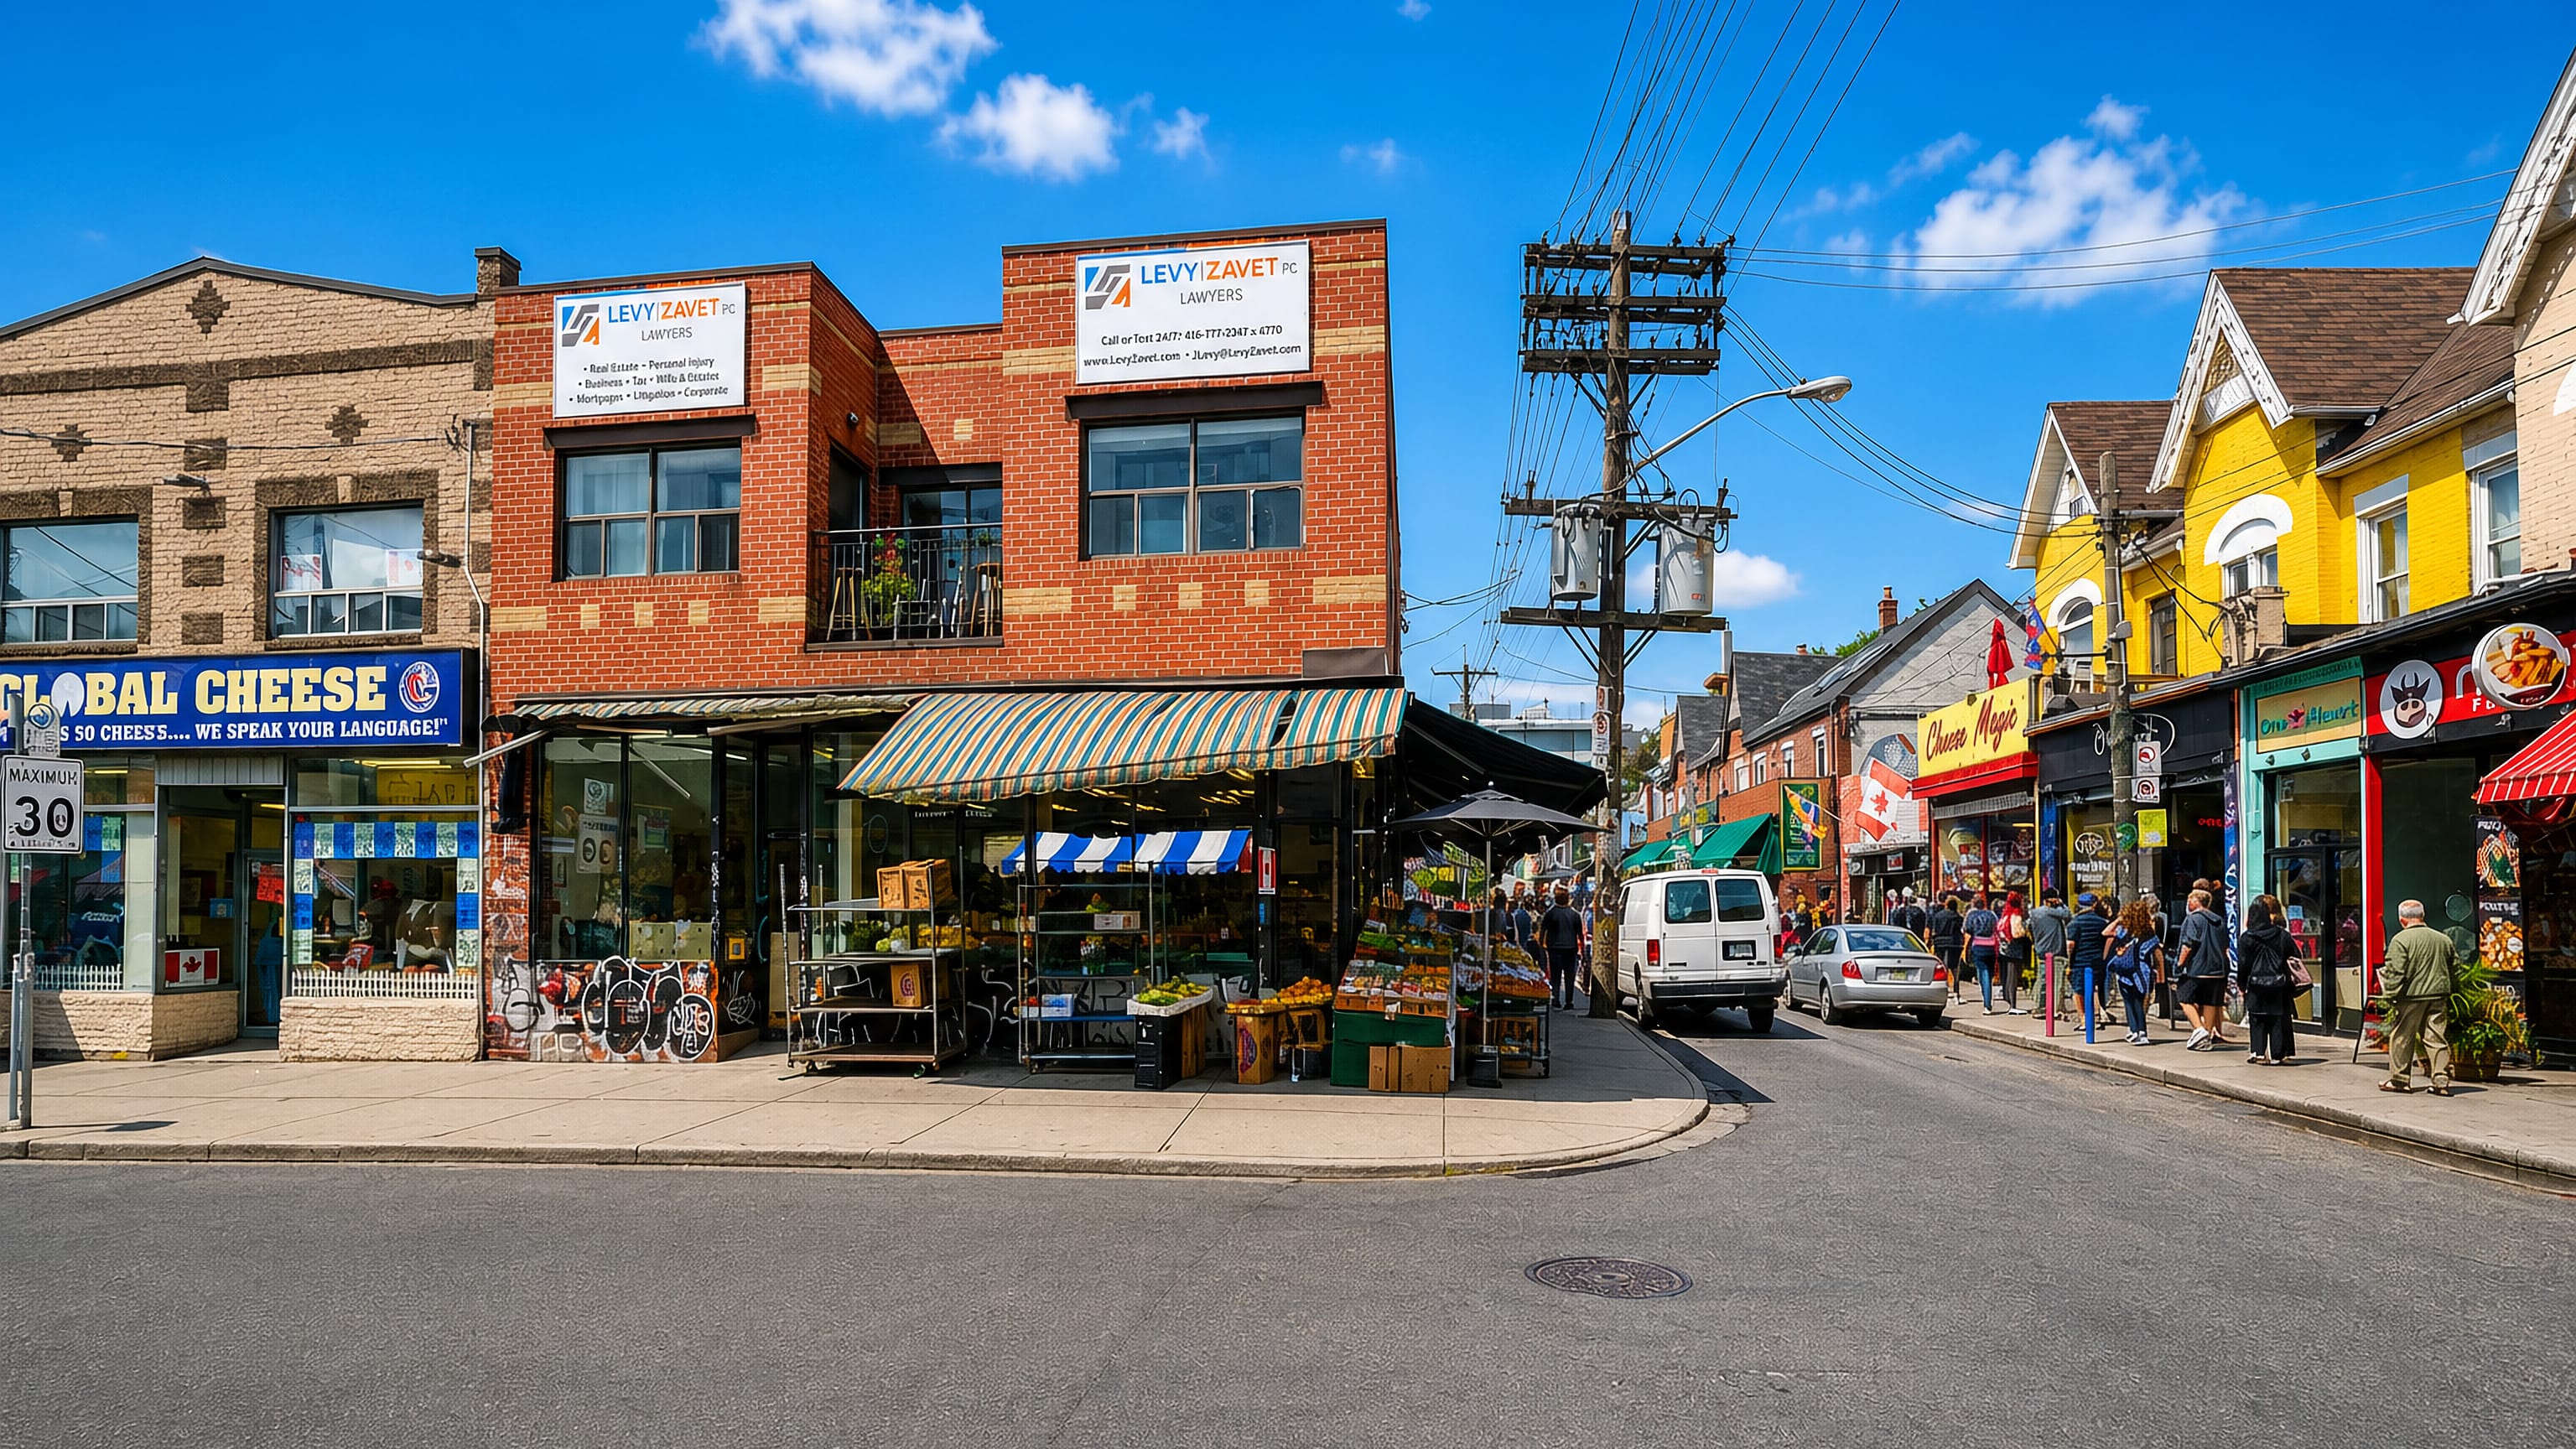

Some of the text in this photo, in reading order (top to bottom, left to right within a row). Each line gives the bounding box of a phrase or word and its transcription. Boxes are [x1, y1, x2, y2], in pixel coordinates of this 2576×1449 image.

[1282, 262, 1298, 275] PC
[1181, 288, 1243, 304] LAWYERS
[722, 304, 736, 314] PC
[641, 327, 693, 341] LAWYERS
[1121, 336, 1133, 345] or
[195, 666, 387, 714] CHEESE
[75, 724, 95, 741] SO
[195, 723, 222, 740] WE
[226, 721, 283, 740] SPEAK
[288, 720, 335, 739] YOUR
[14, 795, 75, 838] 30
